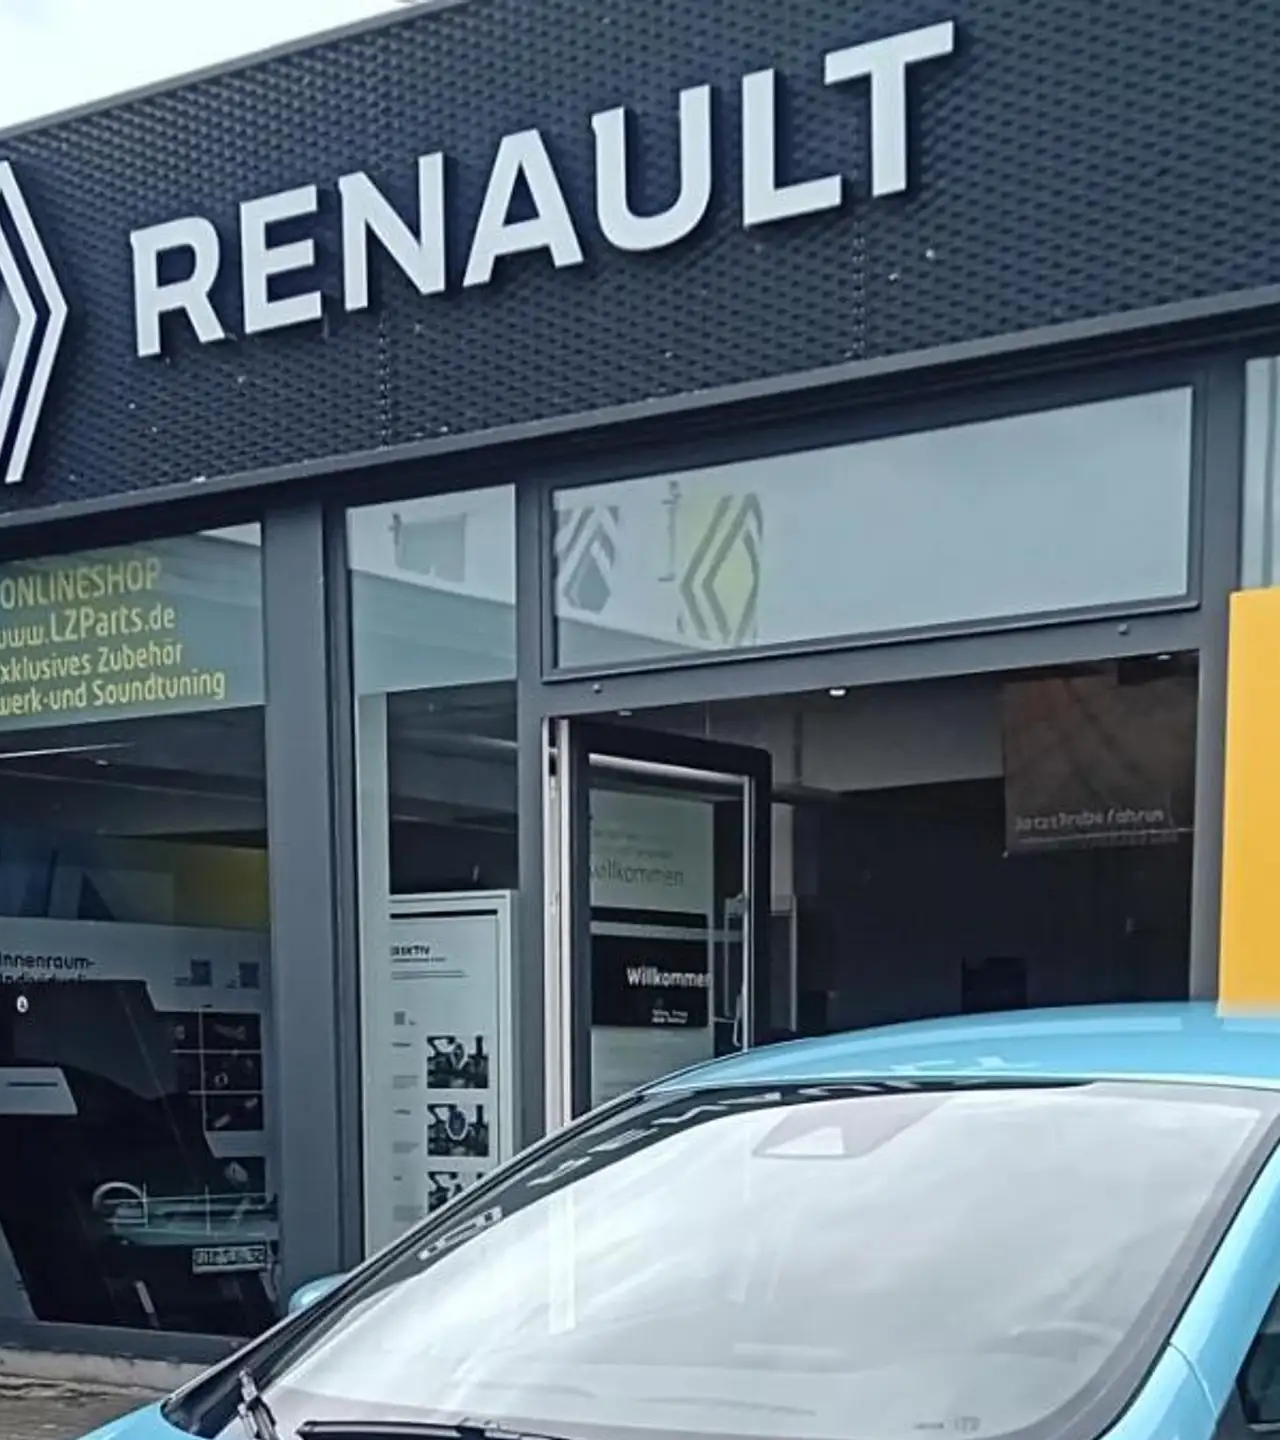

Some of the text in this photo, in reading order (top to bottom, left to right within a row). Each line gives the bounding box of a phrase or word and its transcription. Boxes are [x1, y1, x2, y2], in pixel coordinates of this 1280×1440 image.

[129, 20, 955, 359] RENAULT
[0, 556, 162, 610] ONLINESHOP
[97, 637, 184, 674] Zubehör
[92, 667, 226, 706] Soundtuning
